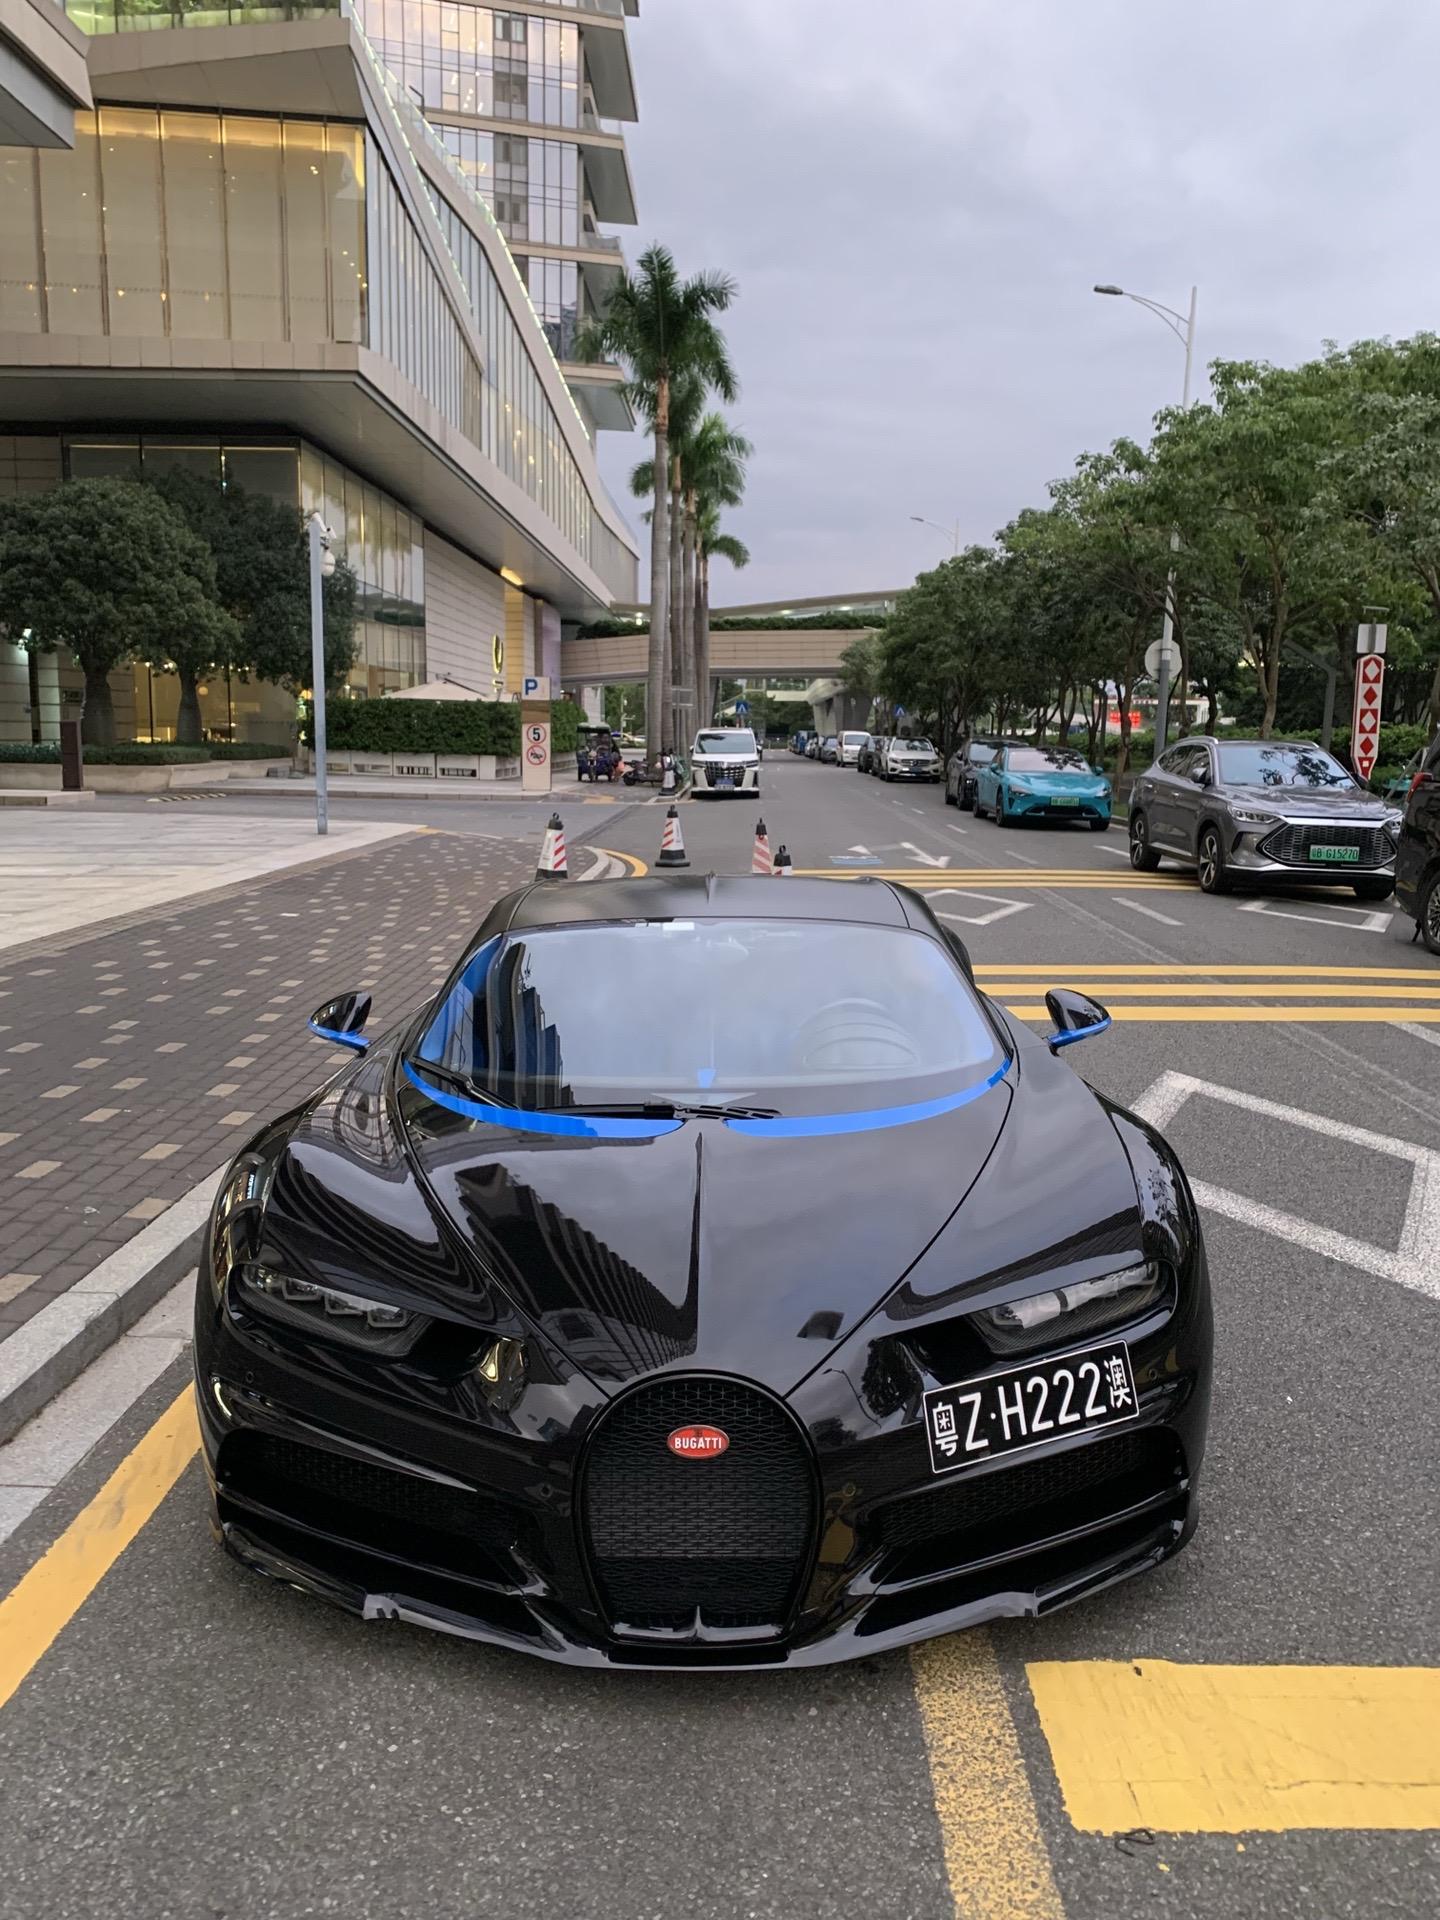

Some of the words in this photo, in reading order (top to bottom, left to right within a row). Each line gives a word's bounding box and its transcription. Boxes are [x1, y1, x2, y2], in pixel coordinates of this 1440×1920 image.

[525, 679, 538, 696] P
[532, 728, 541, 741] 5
[932, 1355, 1132, 1457] 粤Z·H222澳
[674, 1437, 722, 1449] BUGATTI
